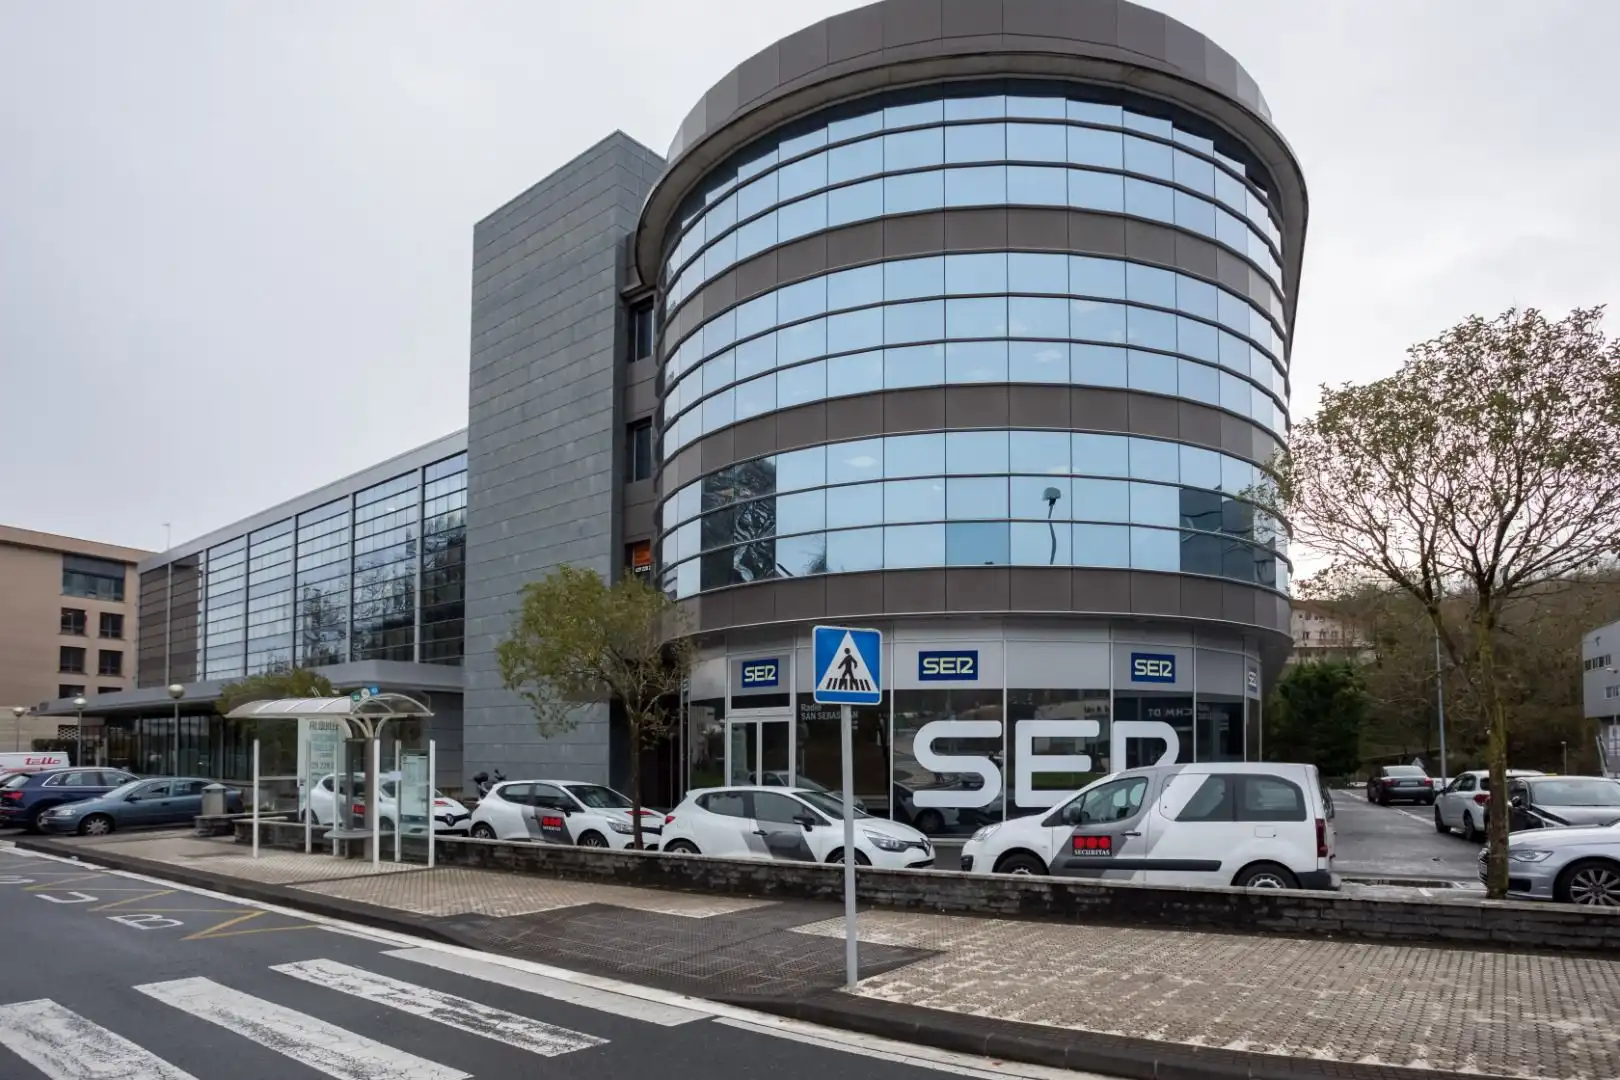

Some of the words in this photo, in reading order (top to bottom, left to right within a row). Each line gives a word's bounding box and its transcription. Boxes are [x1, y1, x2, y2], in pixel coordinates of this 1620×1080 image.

[744, 665, 776, 682] SER
[922, 656, 974, 675] SER
[1134, 658, 1173, 677] SER
[1074, 848, 1111, 856] SECURITAS
